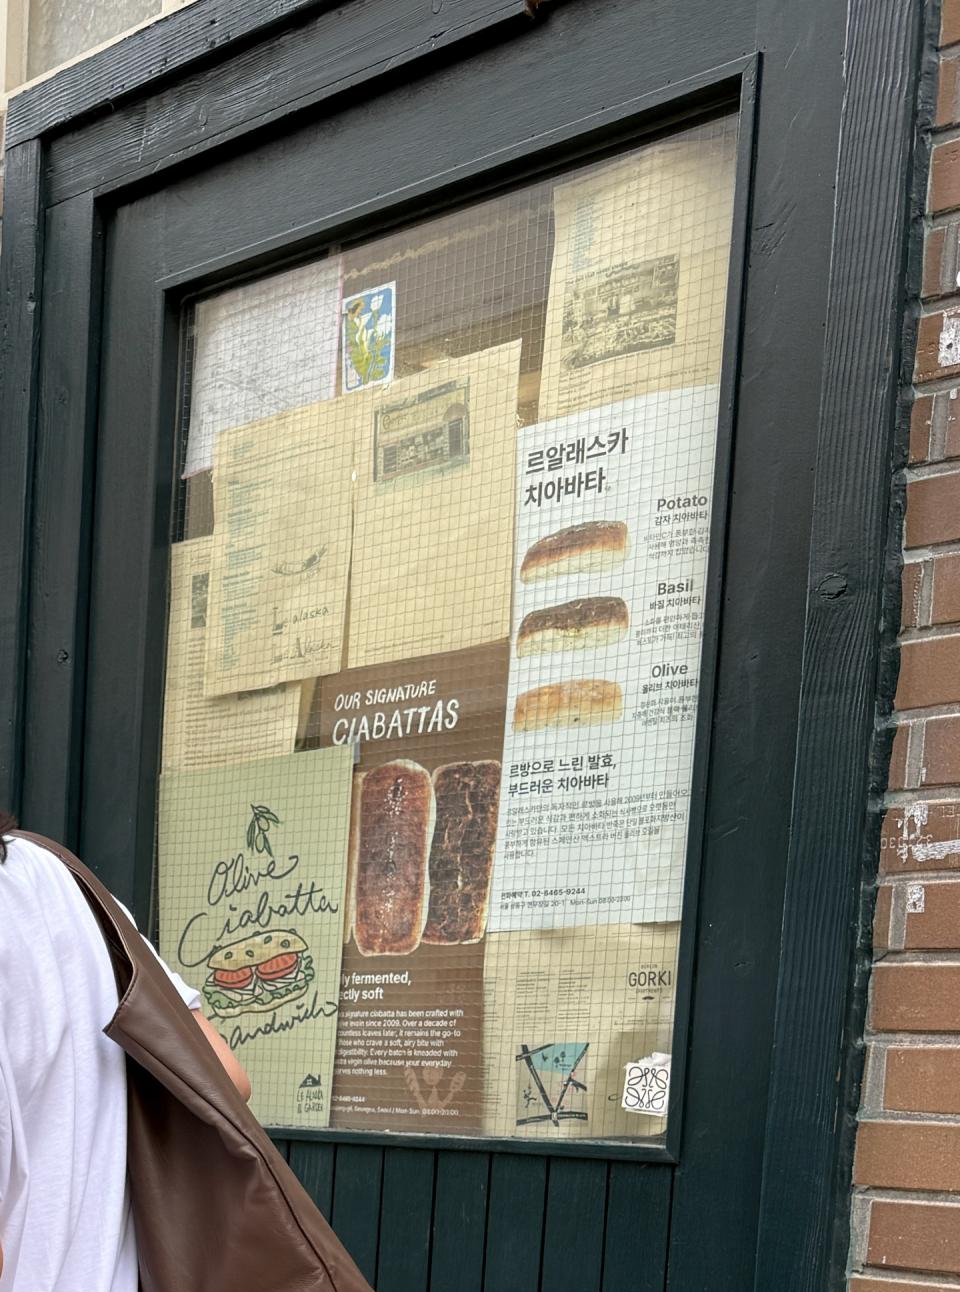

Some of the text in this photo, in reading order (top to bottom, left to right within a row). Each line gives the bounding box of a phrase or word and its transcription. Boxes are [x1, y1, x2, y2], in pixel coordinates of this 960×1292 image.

[525, 428, 629, 475] 르알래스카
[524, 467, 606, 507] 치아바타
[657, 495, 708, 512] Potato
[655, 510, 708, 526] 감자 치아바타
[658, 578, 693, 596] Basil
[650, 596, 701, 610] 바질 치아바타
[652, 663, 688, 678] Olive
[642, 679, 698, 694] 올리브 치아바타
[334, 680, 437, 712] OUR SIGNATURE
[332, 699, 460, 745] CIABATTAS
[509, 753, 617, 778] 르방으로 느린 발효,
[508, 773, 609, 797] 부드러운 치아바타
[207, 853, 300, 906] Olive
[178, 882, 339, 968] Ciabatta
[341, 971, 412, 988] ly fermented,
[628, 970, 672, 987] GORKI
[361, 986, 384, 1000] soft
[396, 1009, 408, 1017] has
[408, 1009, 425, 1017] been
[425, 1008, 448, 1017] crafted
[449, 1009, 464, 1017] with
[365, 1019, 382, 1027] since
[402, 1019, 418, 1027] Over
[423, 1019, 448, 1027] decade
[449, 1019, 457, 1027] of
[404, 1029, 429, 1037] remains
[430, 1029, 441, 1037] the
[442, 1029, 461, 1039] go-to
[403, 1038, 416, 1048] airy
[430, 1039, 445, 1047] with
[370, 1048, 388, 1057] Every
[413, 1049, 442, 1057] kneaded
[443, 1049, 458, 1057] with
[378, 1059, 405, 1067] because
[405, 1060, 421, 1068] your
[421, 1060, 452, 1069] everyday
